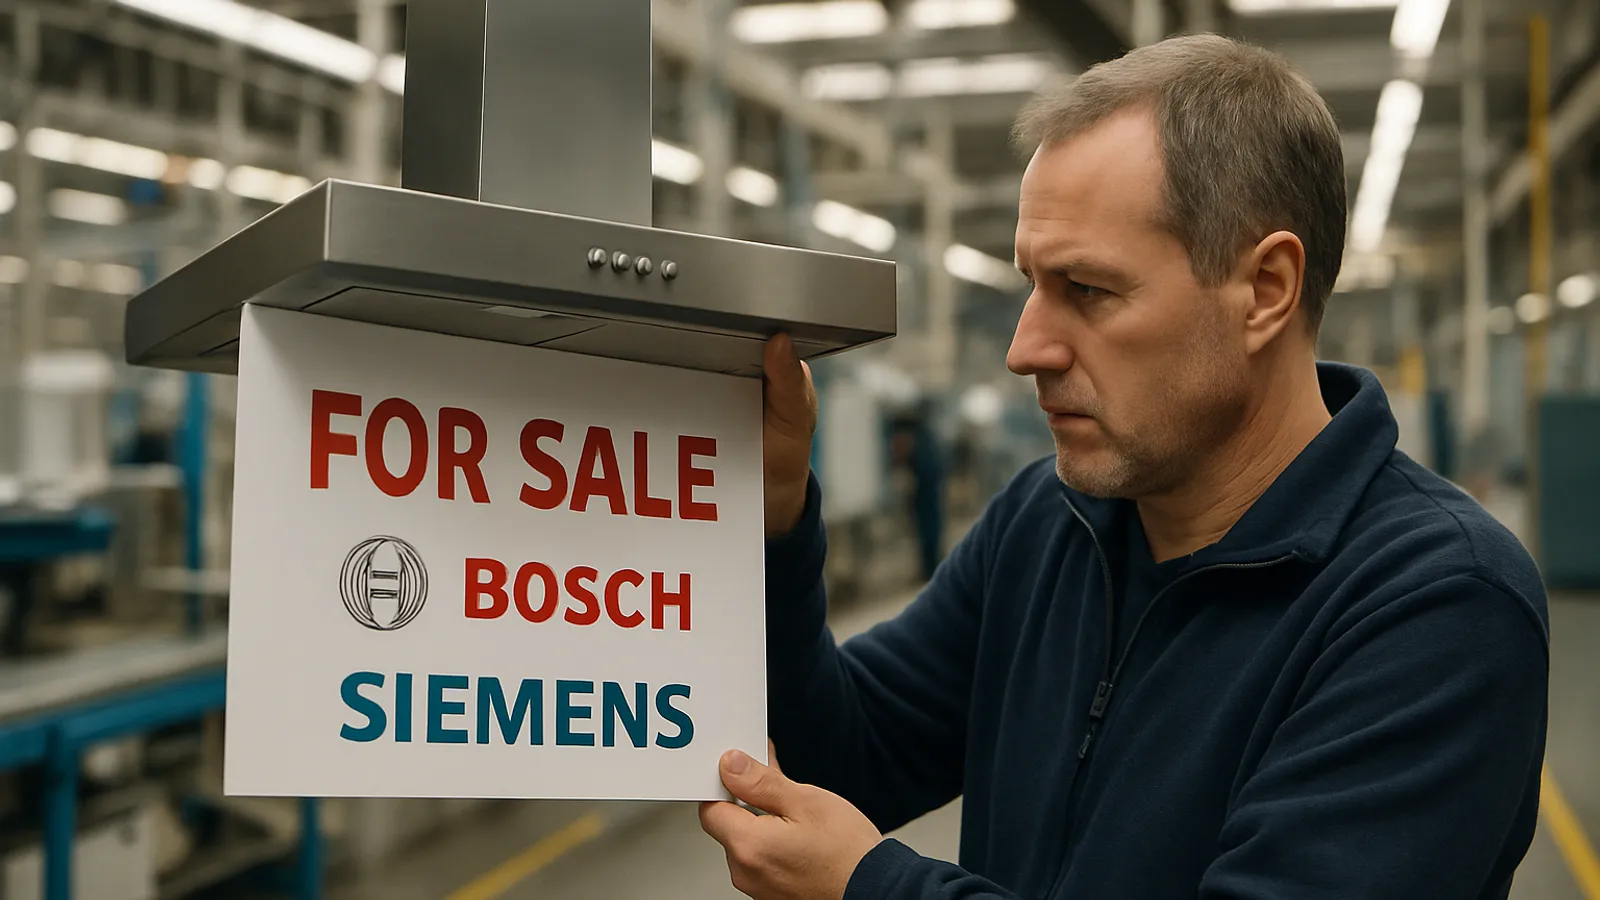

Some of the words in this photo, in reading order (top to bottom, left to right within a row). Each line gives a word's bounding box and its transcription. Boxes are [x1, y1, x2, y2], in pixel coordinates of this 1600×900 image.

[310, 389, 491, 504] FOR
[519, 418, 719, 522] SALE
[464, 557, 692, 632] BOSCH
[339, 671, 694, 749] SIEMENS
